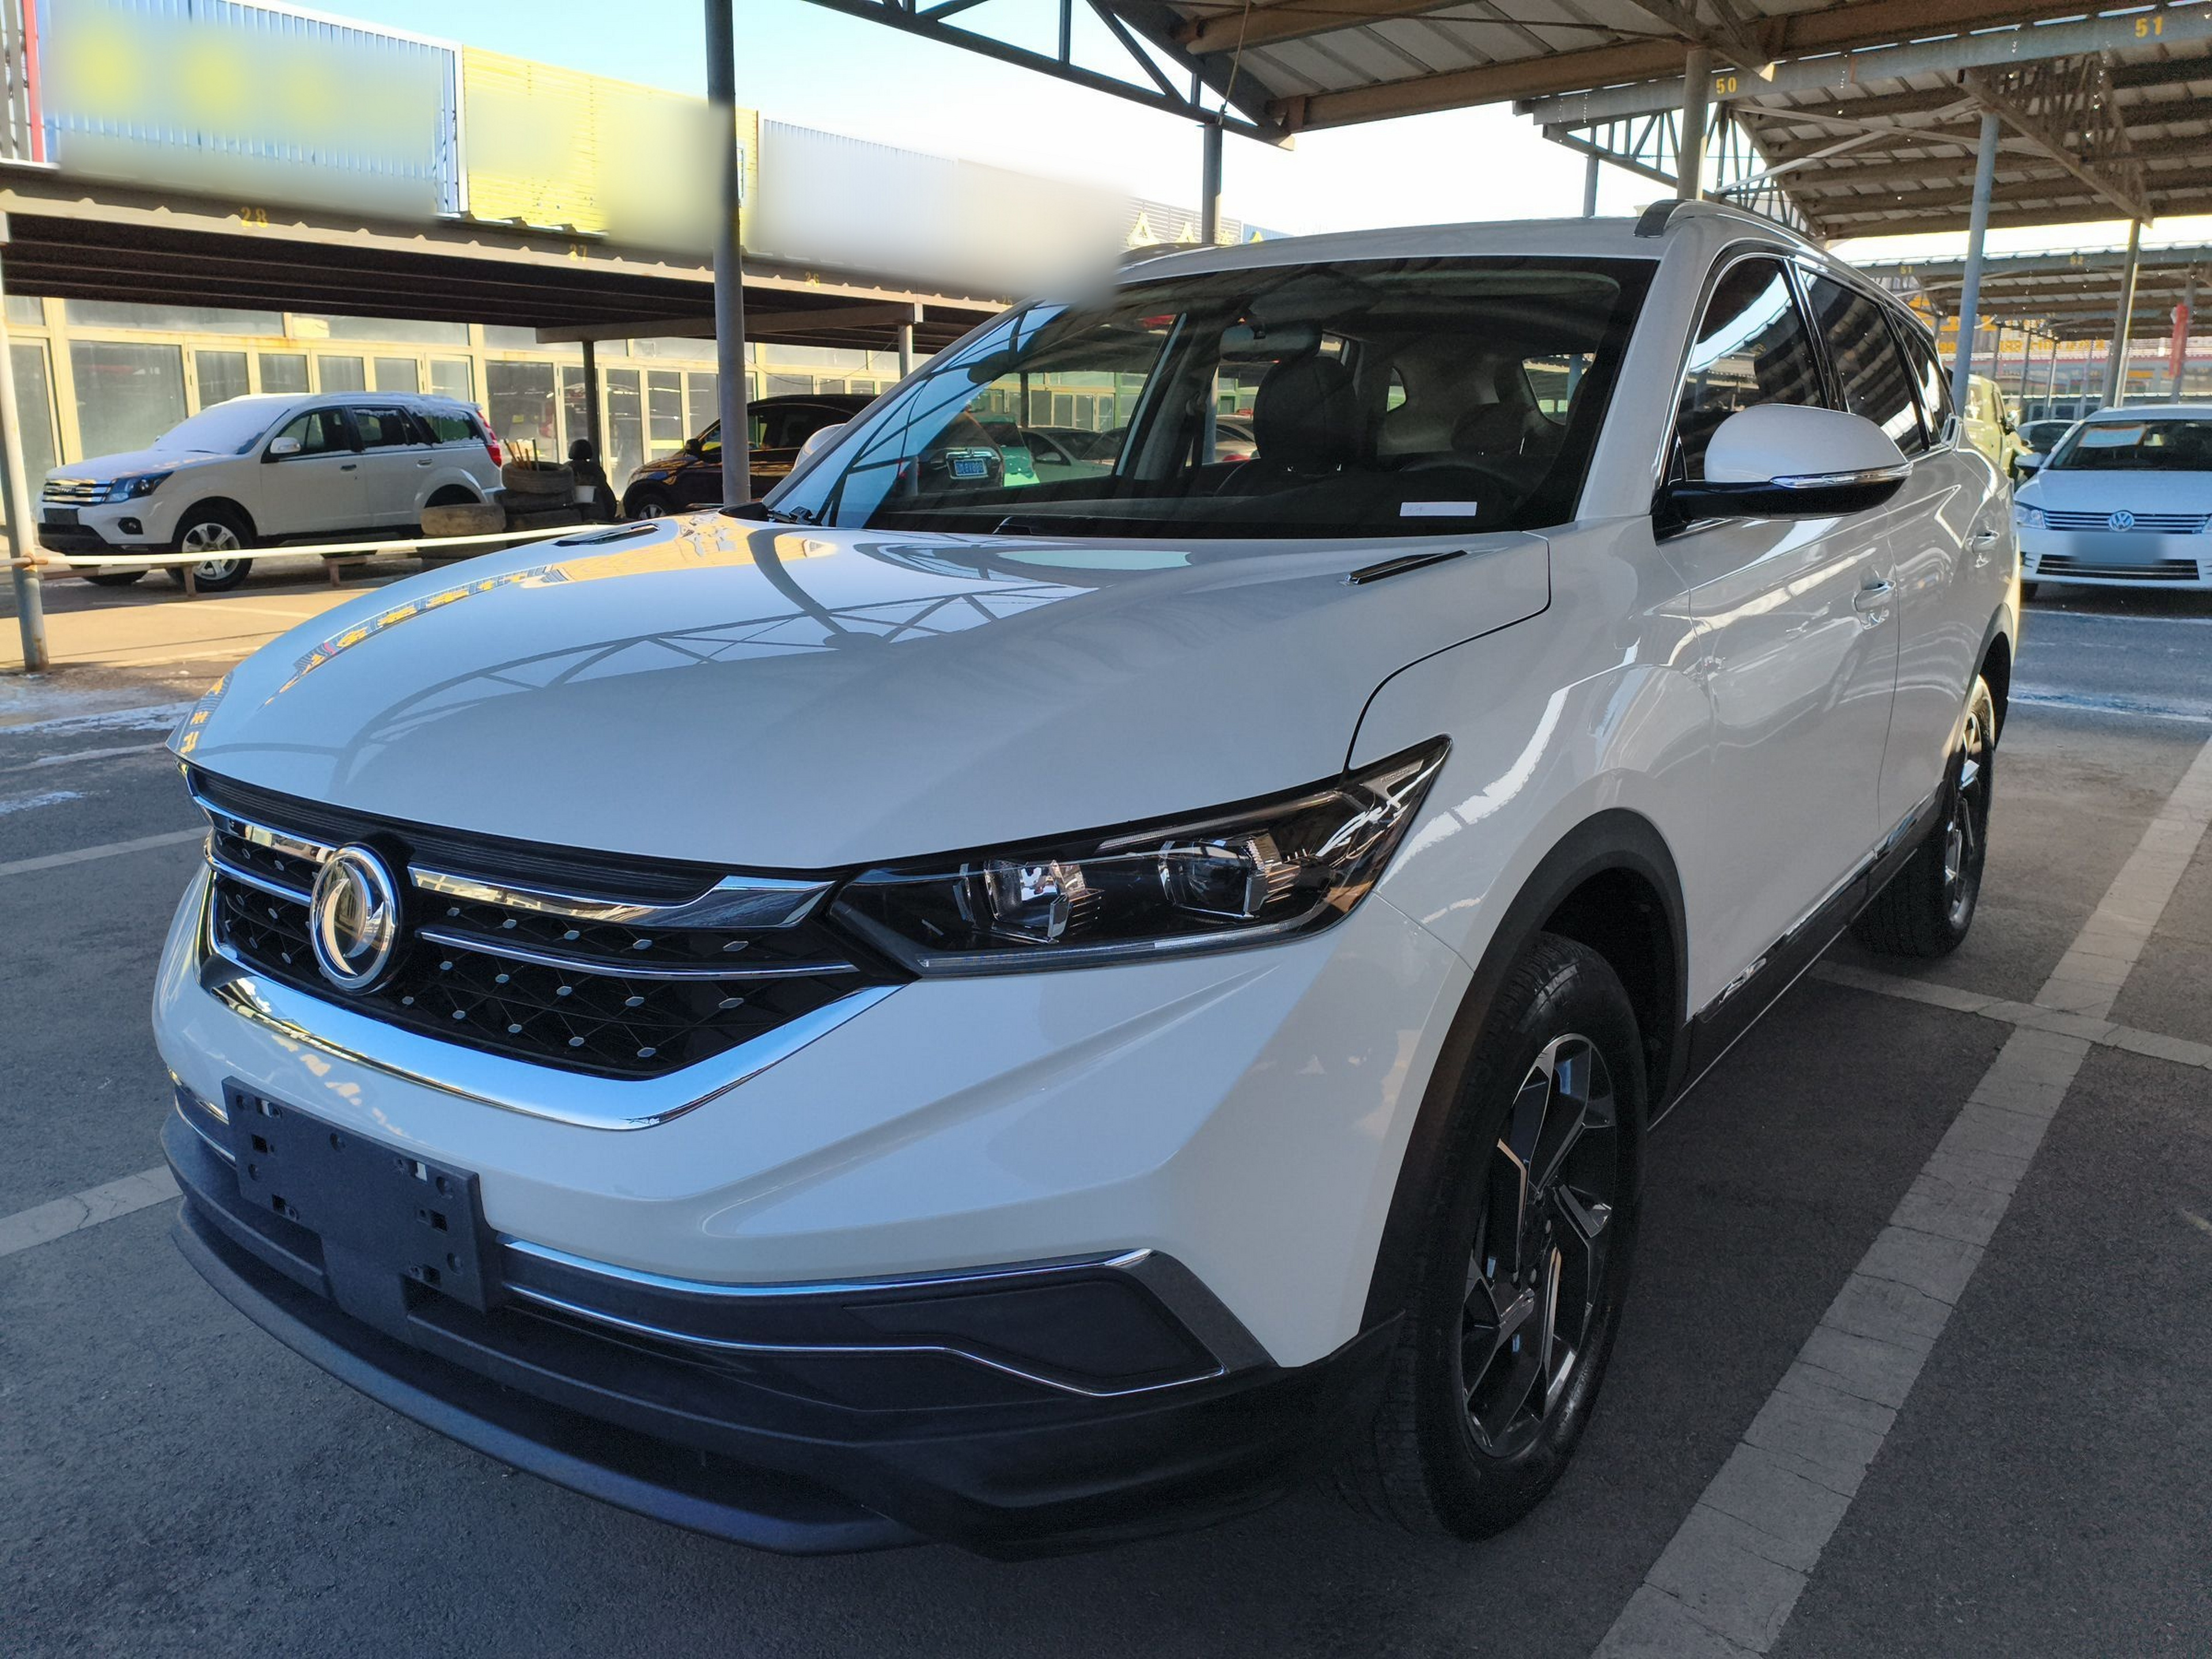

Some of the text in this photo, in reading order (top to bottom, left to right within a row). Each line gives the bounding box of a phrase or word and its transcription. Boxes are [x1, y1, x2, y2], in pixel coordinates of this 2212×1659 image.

[2135, 14, 2162, 38] 51
[1716, 77, 1737, 94] 50
[240, 206, 269, 228] 28
